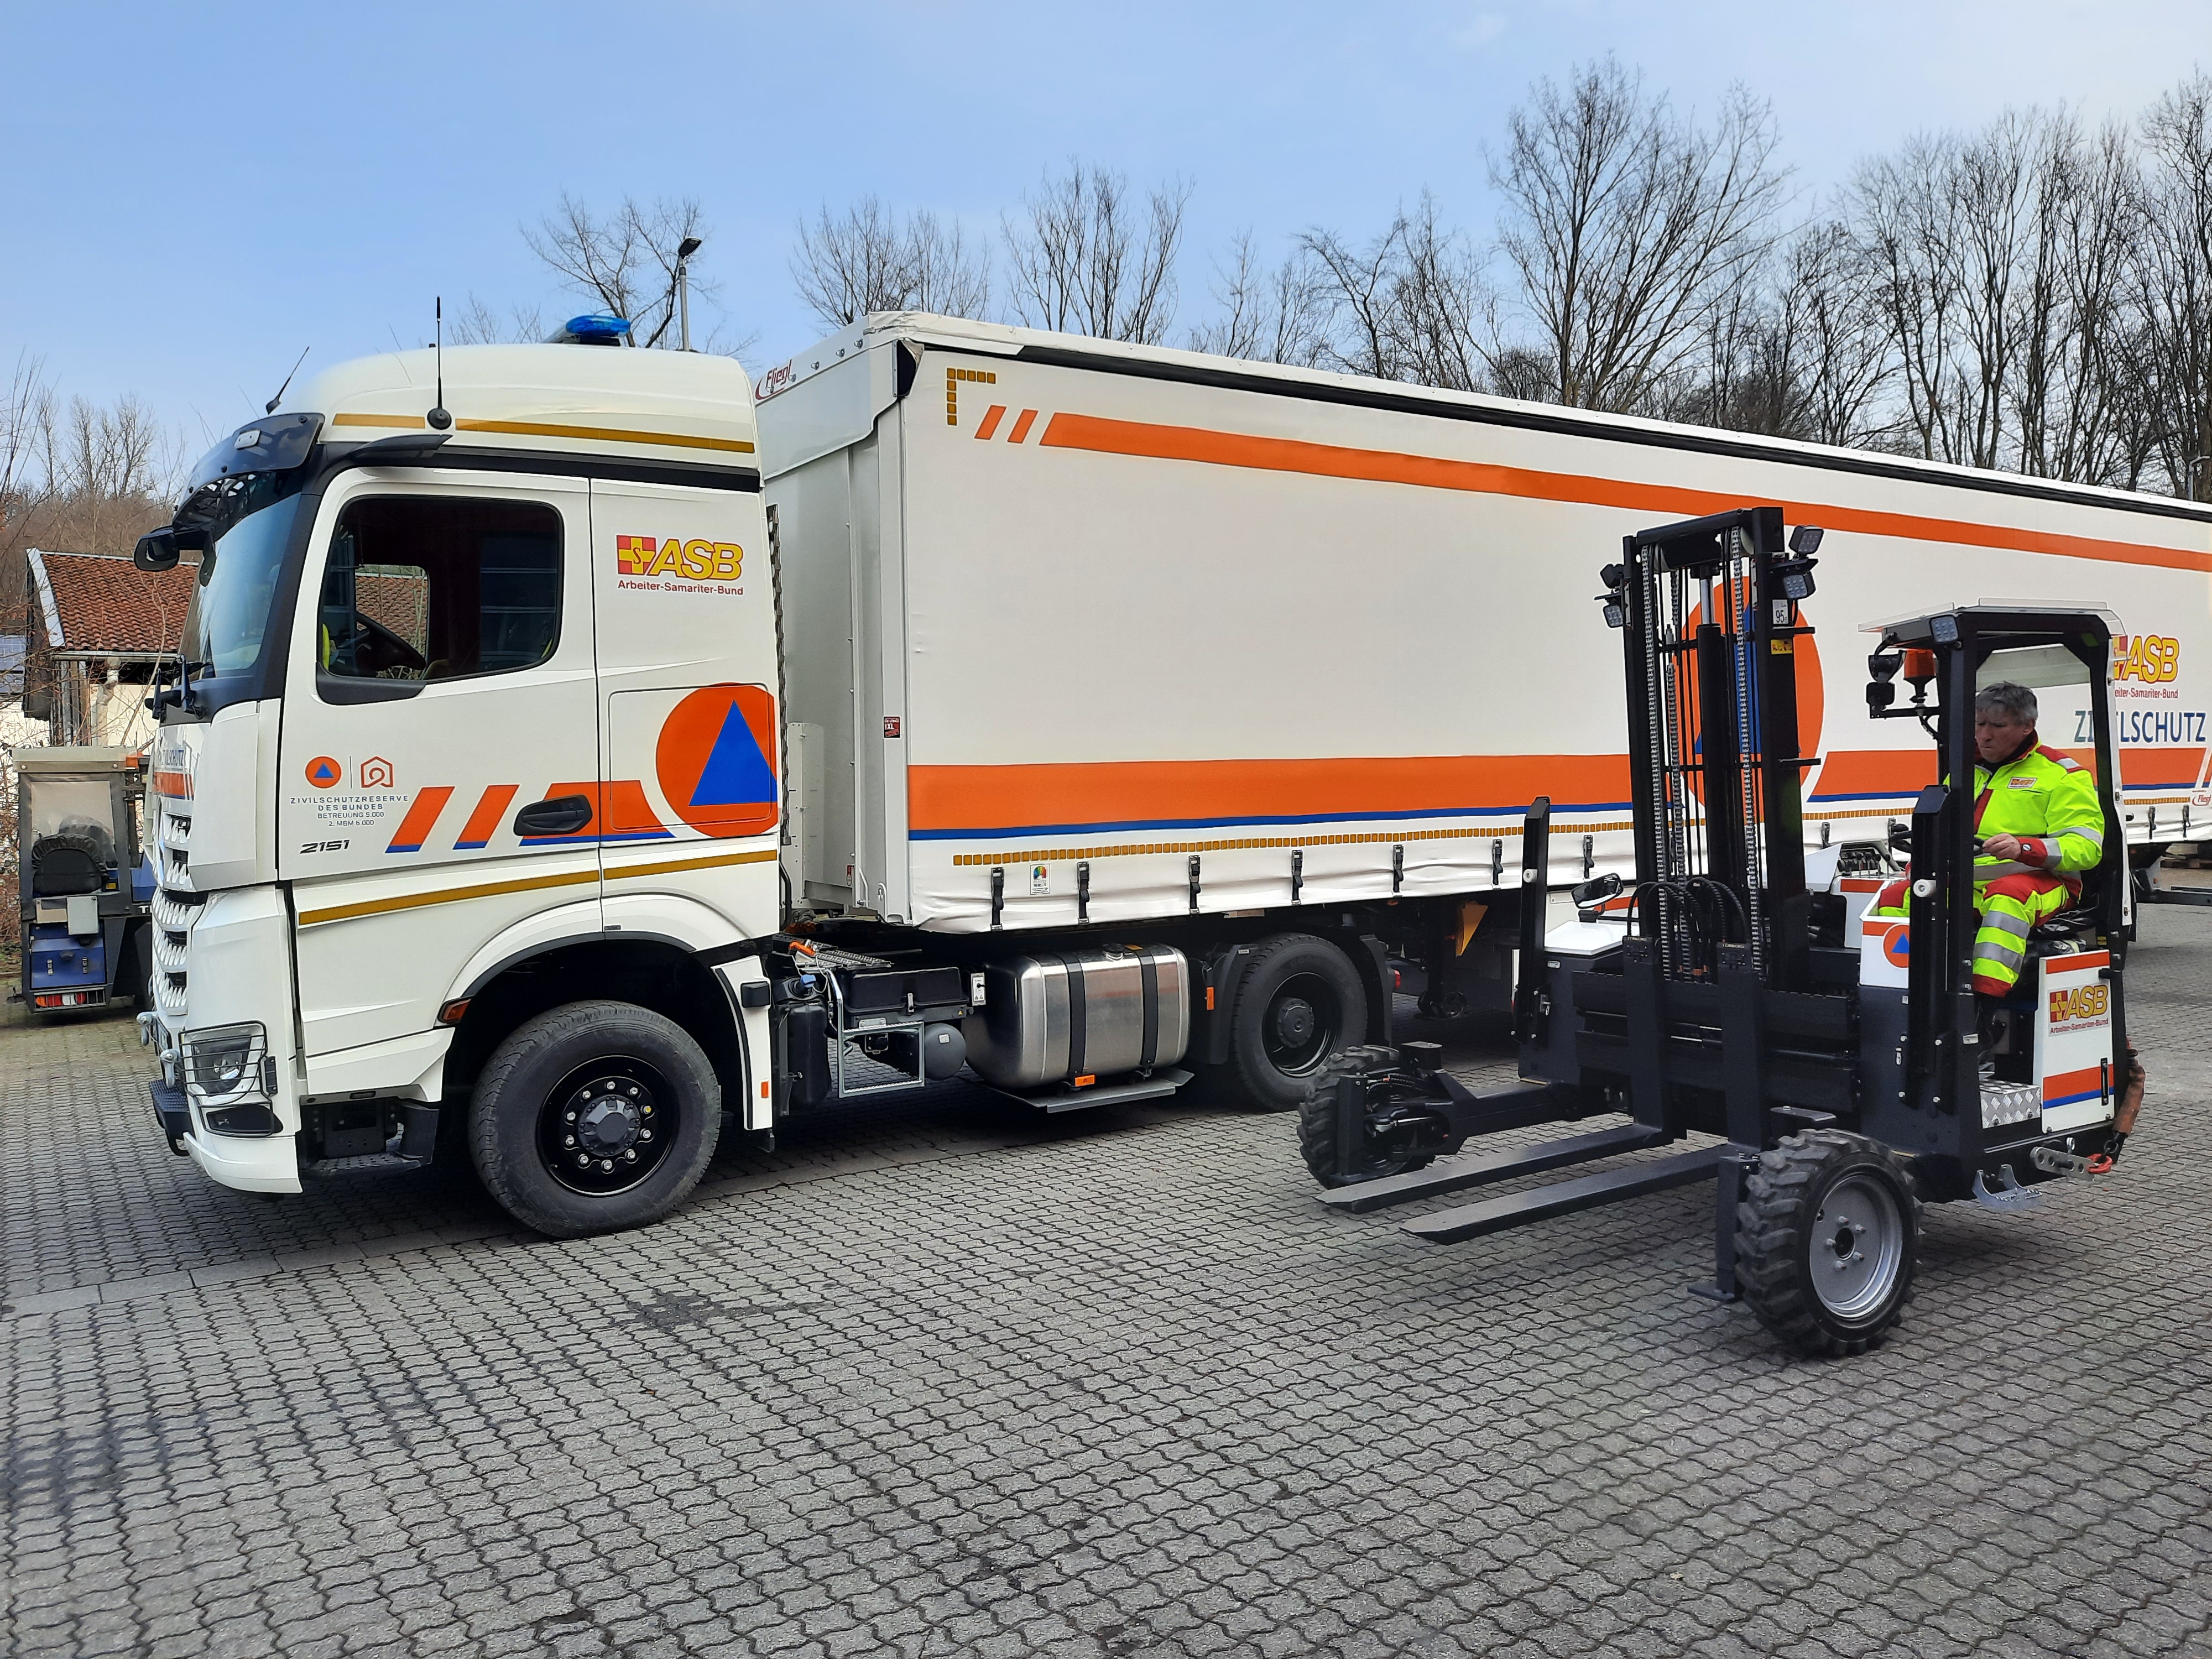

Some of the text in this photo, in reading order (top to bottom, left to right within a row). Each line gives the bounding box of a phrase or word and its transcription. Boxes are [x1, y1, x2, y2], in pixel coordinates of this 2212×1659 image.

[647, 538, 743, 580] ASB
[618, 580, 744, 596] Arbeiter-Samariter-Bund
[1776, 609, 1785, 623] 95
[2122, 634, 2180, 684] ASB
[2115, 688, 2179, 699] eiter-Samariter-Bund
[2074, 710, 2206, 743] ZILSCHUTZ
[290, 795, 409, 804] ZIVILSCHUTZRESERVE
[300, 839, 350, 854] 2151
[2063, 984, 2108, 1021] ASB
